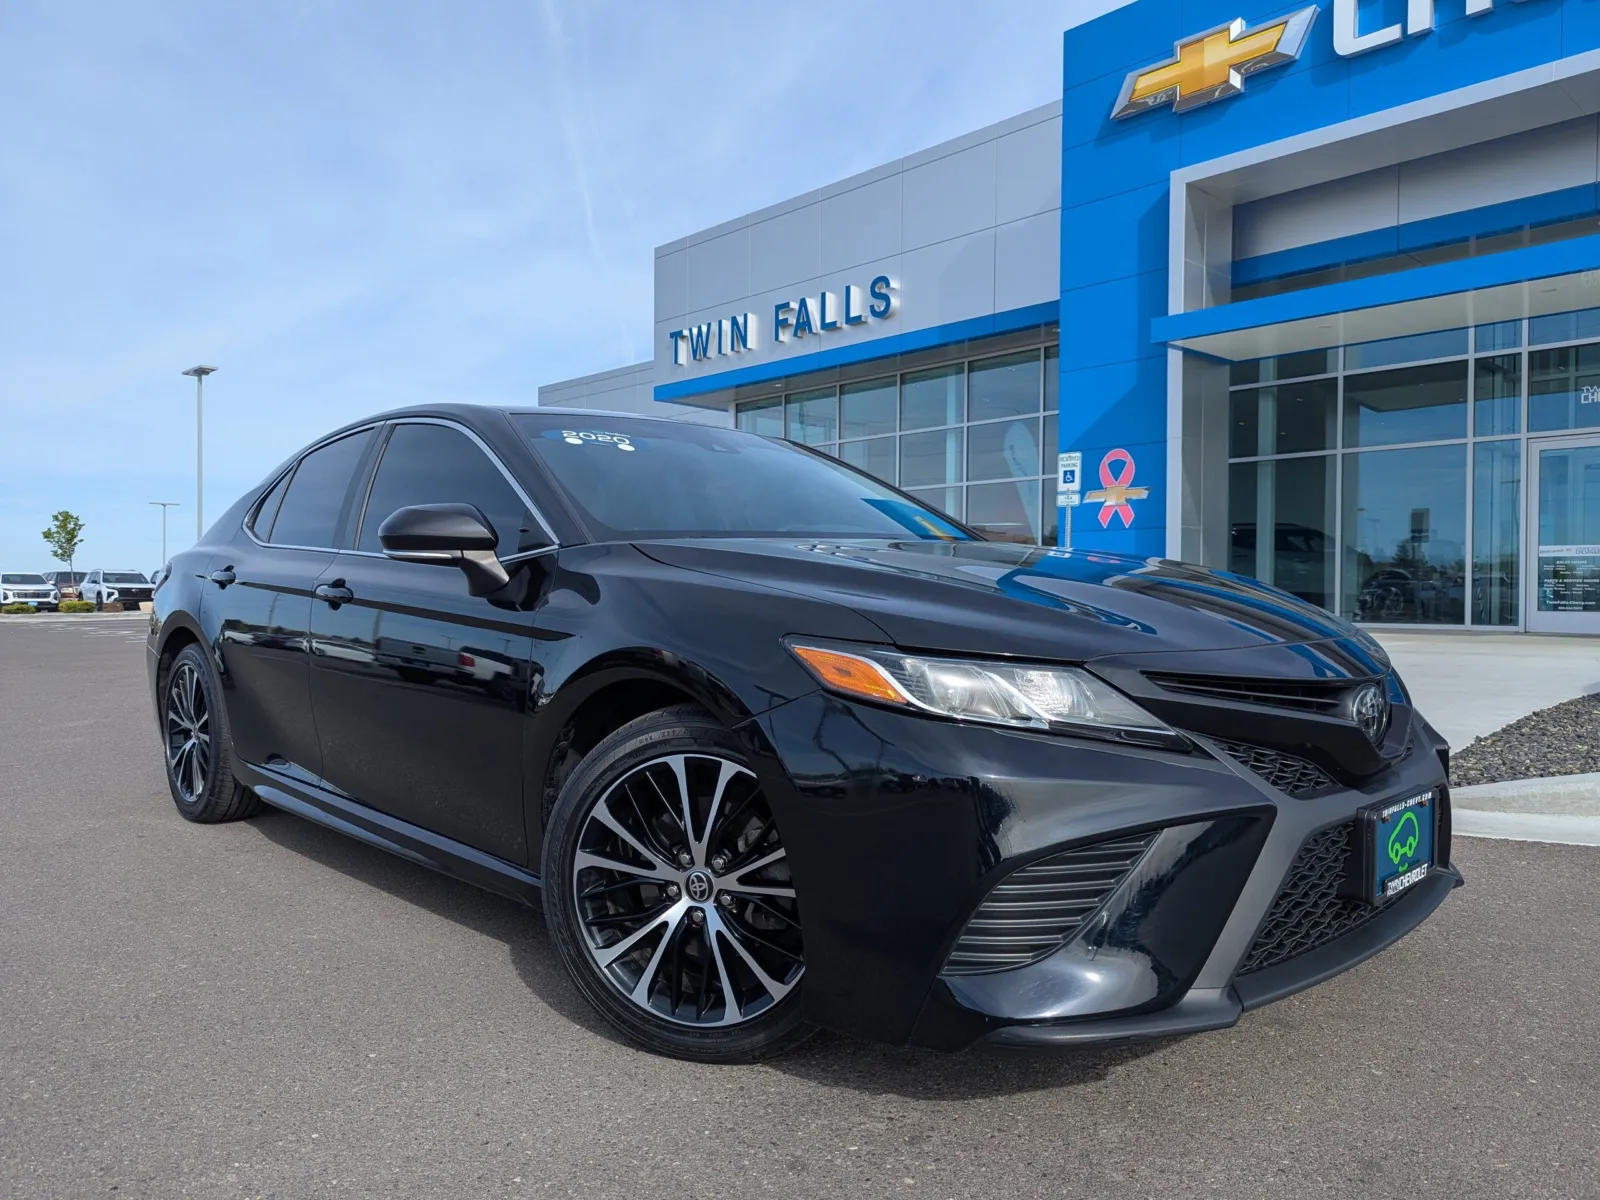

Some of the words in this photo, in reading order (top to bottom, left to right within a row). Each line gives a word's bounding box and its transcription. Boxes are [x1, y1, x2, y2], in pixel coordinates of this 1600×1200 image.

[669, 312, 753, 365] TWIN
[774, 275, 896, 342] FALLS
[562, 430, 630, 444] 2020
[1399, 864, 1428, 890] CHEVROLET
